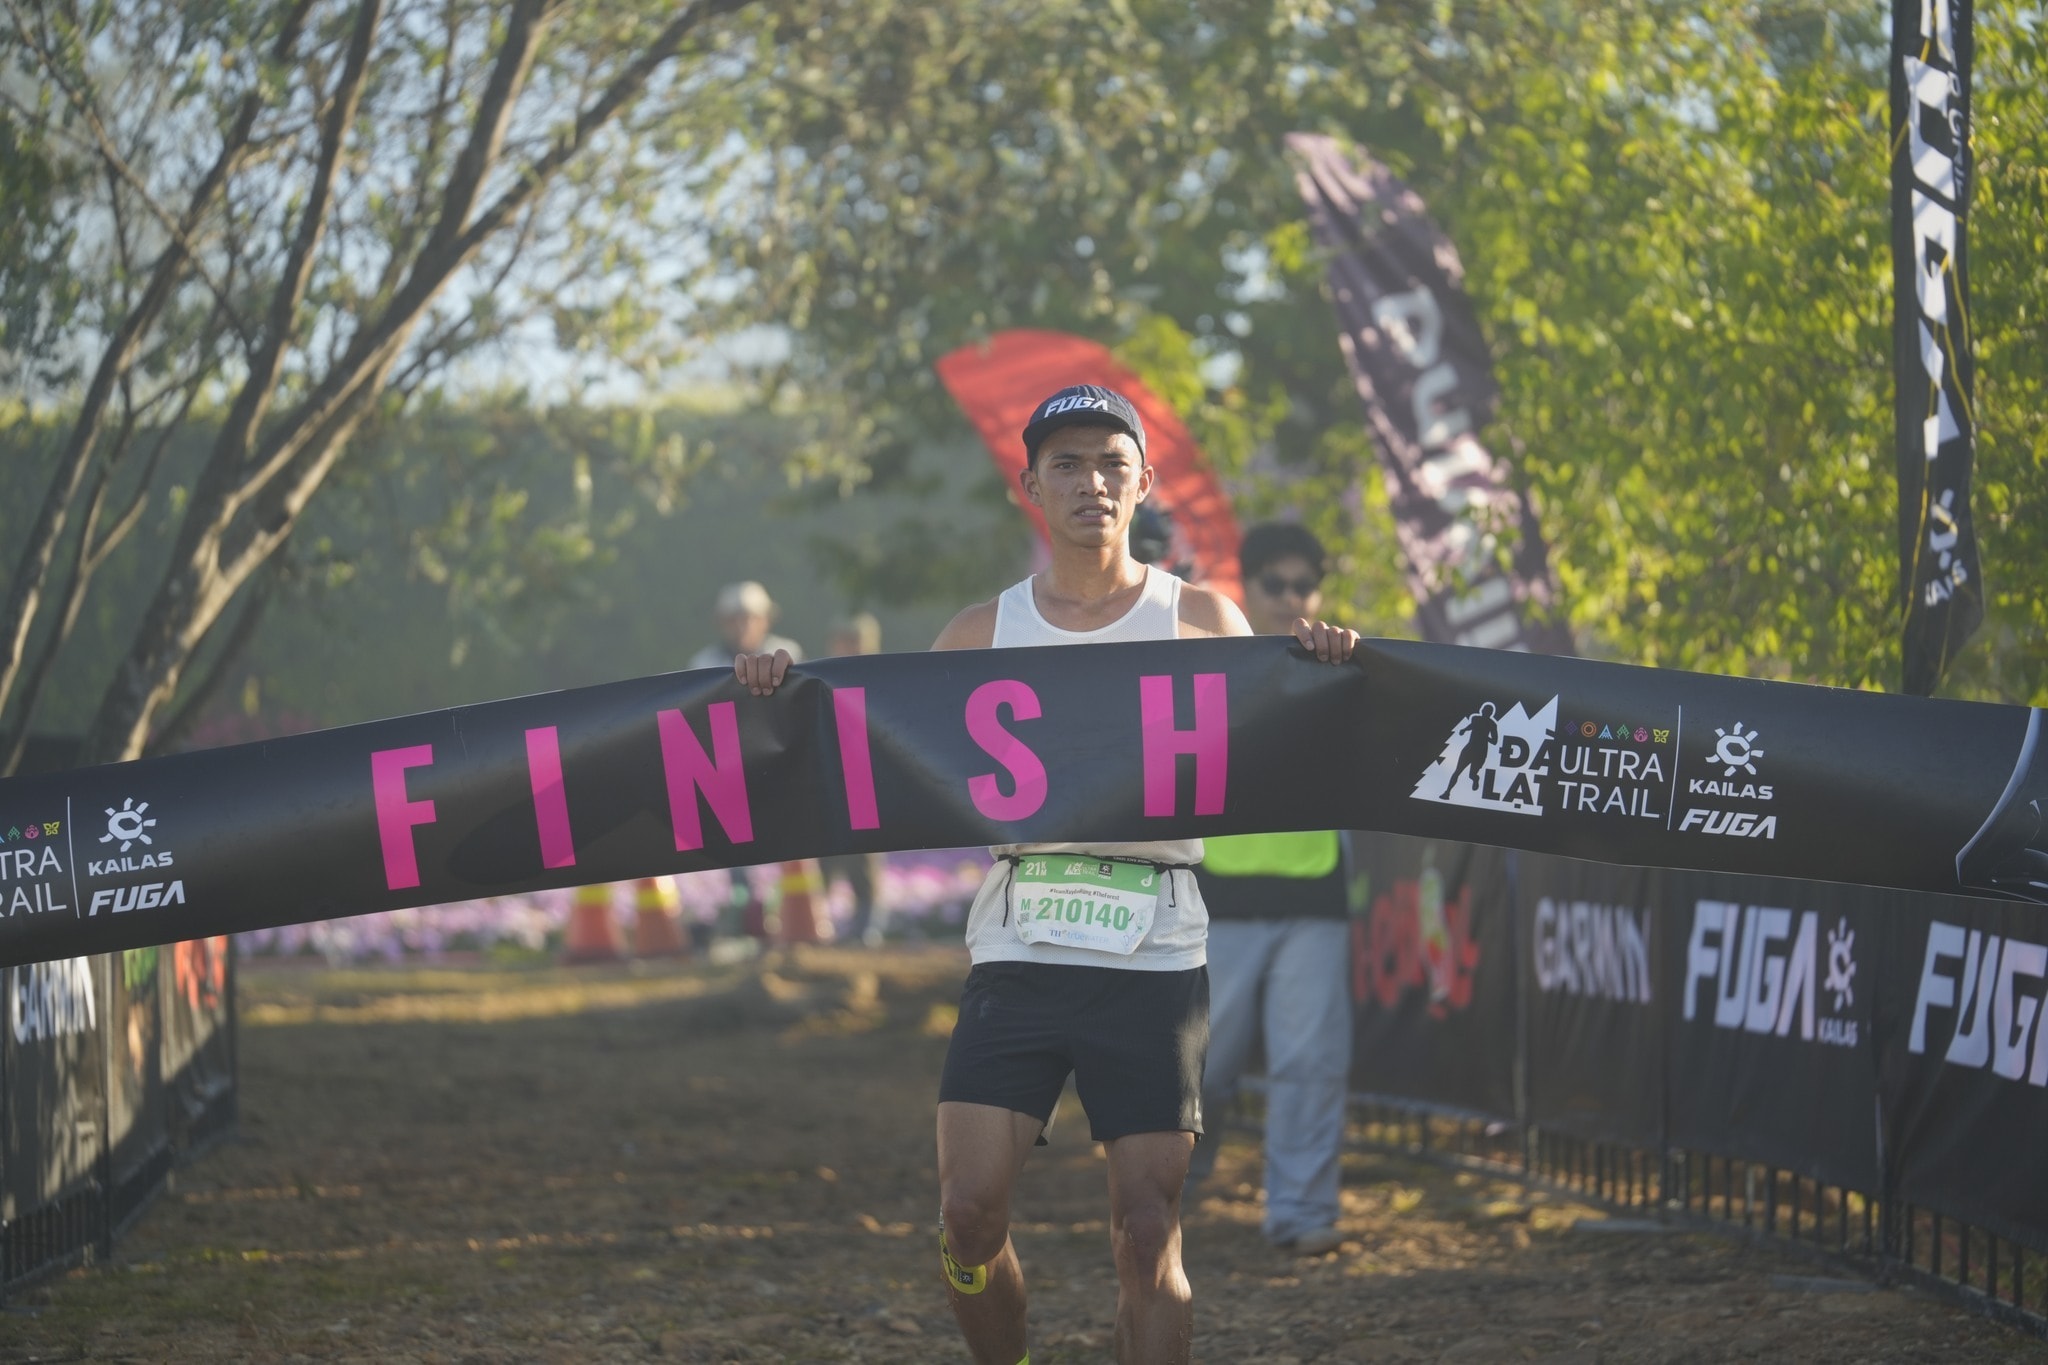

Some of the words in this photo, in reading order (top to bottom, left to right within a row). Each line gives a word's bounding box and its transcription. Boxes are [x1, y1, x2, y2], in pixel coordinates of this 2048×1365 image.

[1044, 396, 1109, 418] FUGA
[1560, 744, 1665, 782] ULTRA
[371, 672, 1229, 890] FINISH
[1688, 779, 1774, 801] KAILAS
[1557, 780, 1661, 819] TRAIL
[1679, 808, 1777, 839] FUGA
[88, 851, 174, 877] KAILAS
[88, 880, 186, 916] FUGA
[1021, 898, 1031, 911] M
[1035, 897, 1129, 931] 210140
[1684, 899, 1818, 1040] FUGA
